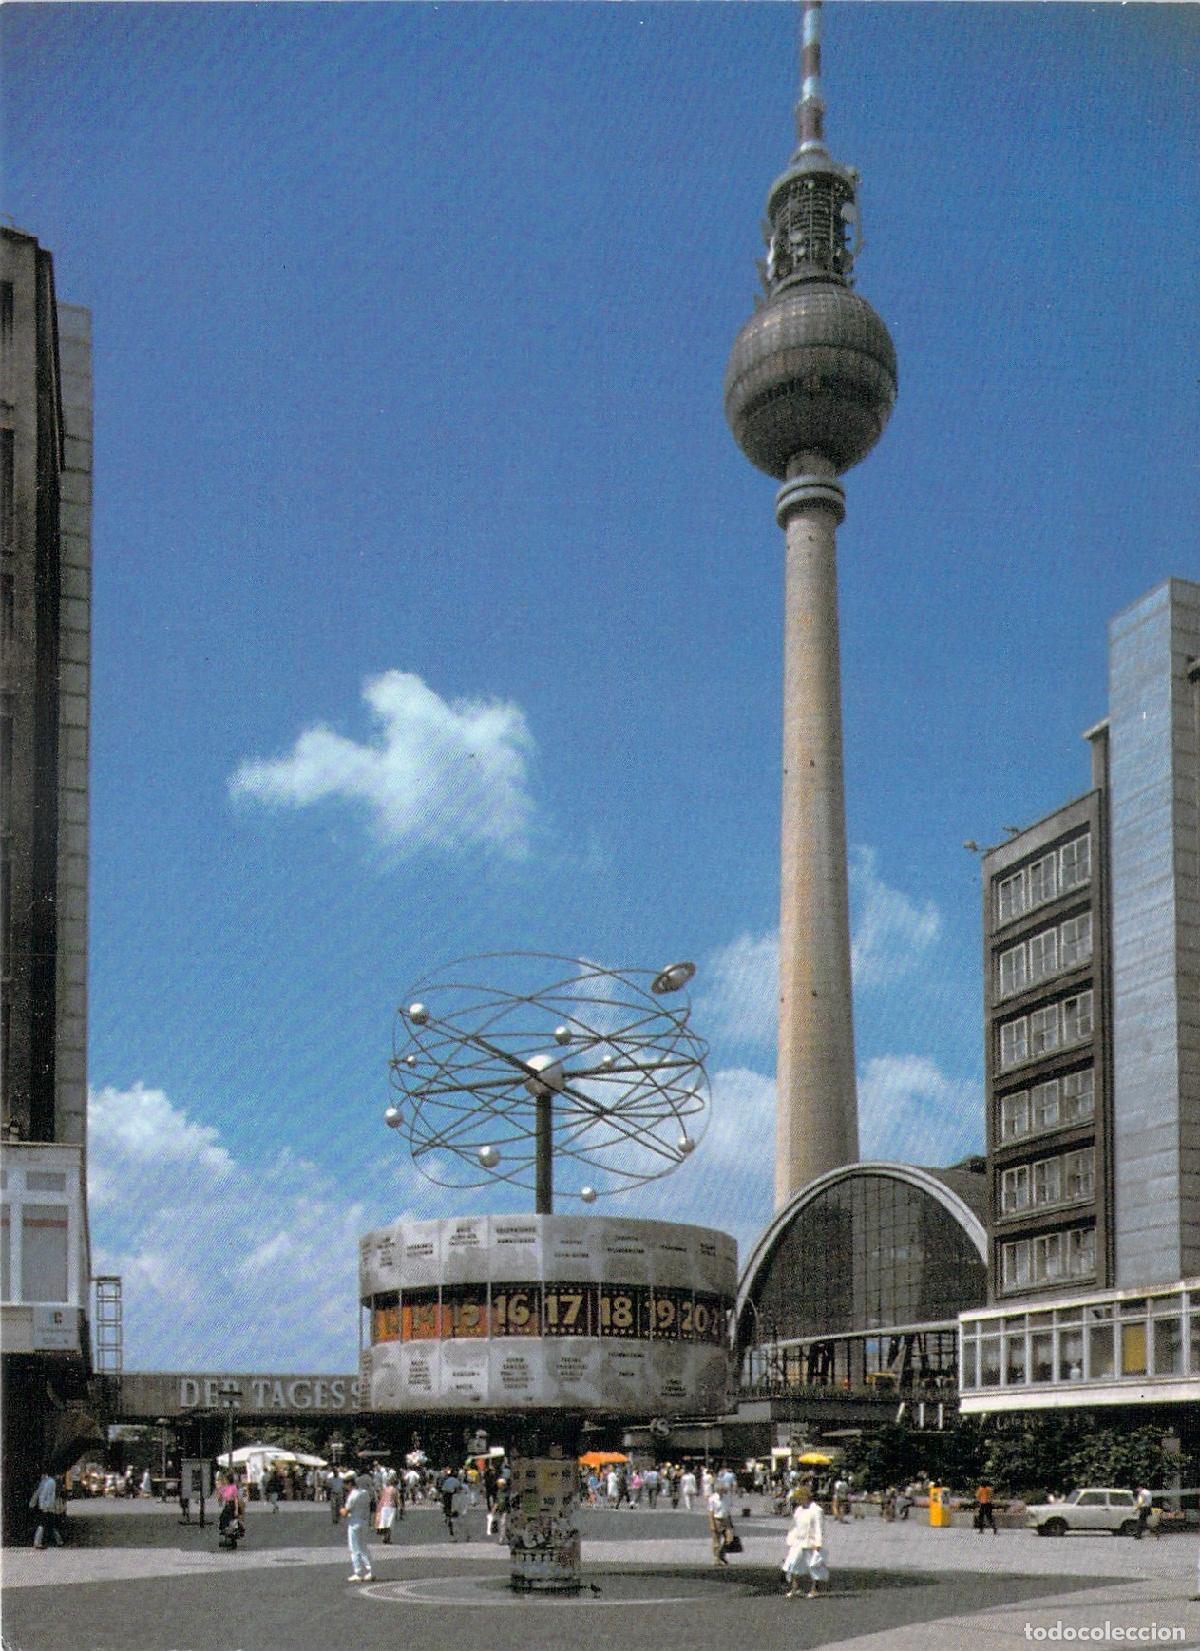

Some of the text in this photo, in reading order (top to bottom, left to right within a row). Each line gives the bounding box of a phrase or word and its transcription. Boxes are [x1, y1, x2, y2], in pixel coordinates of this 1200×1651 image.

[493, 1294, 530, 1325] 16
[544, 1295, 583, 1325] 17
[600, 1297, 633, 1328] 18
[644, 1299, 676, 1328] 19
[681, 1301, 709, 1333] 20
[179, 1378, 241, 1408] DER
